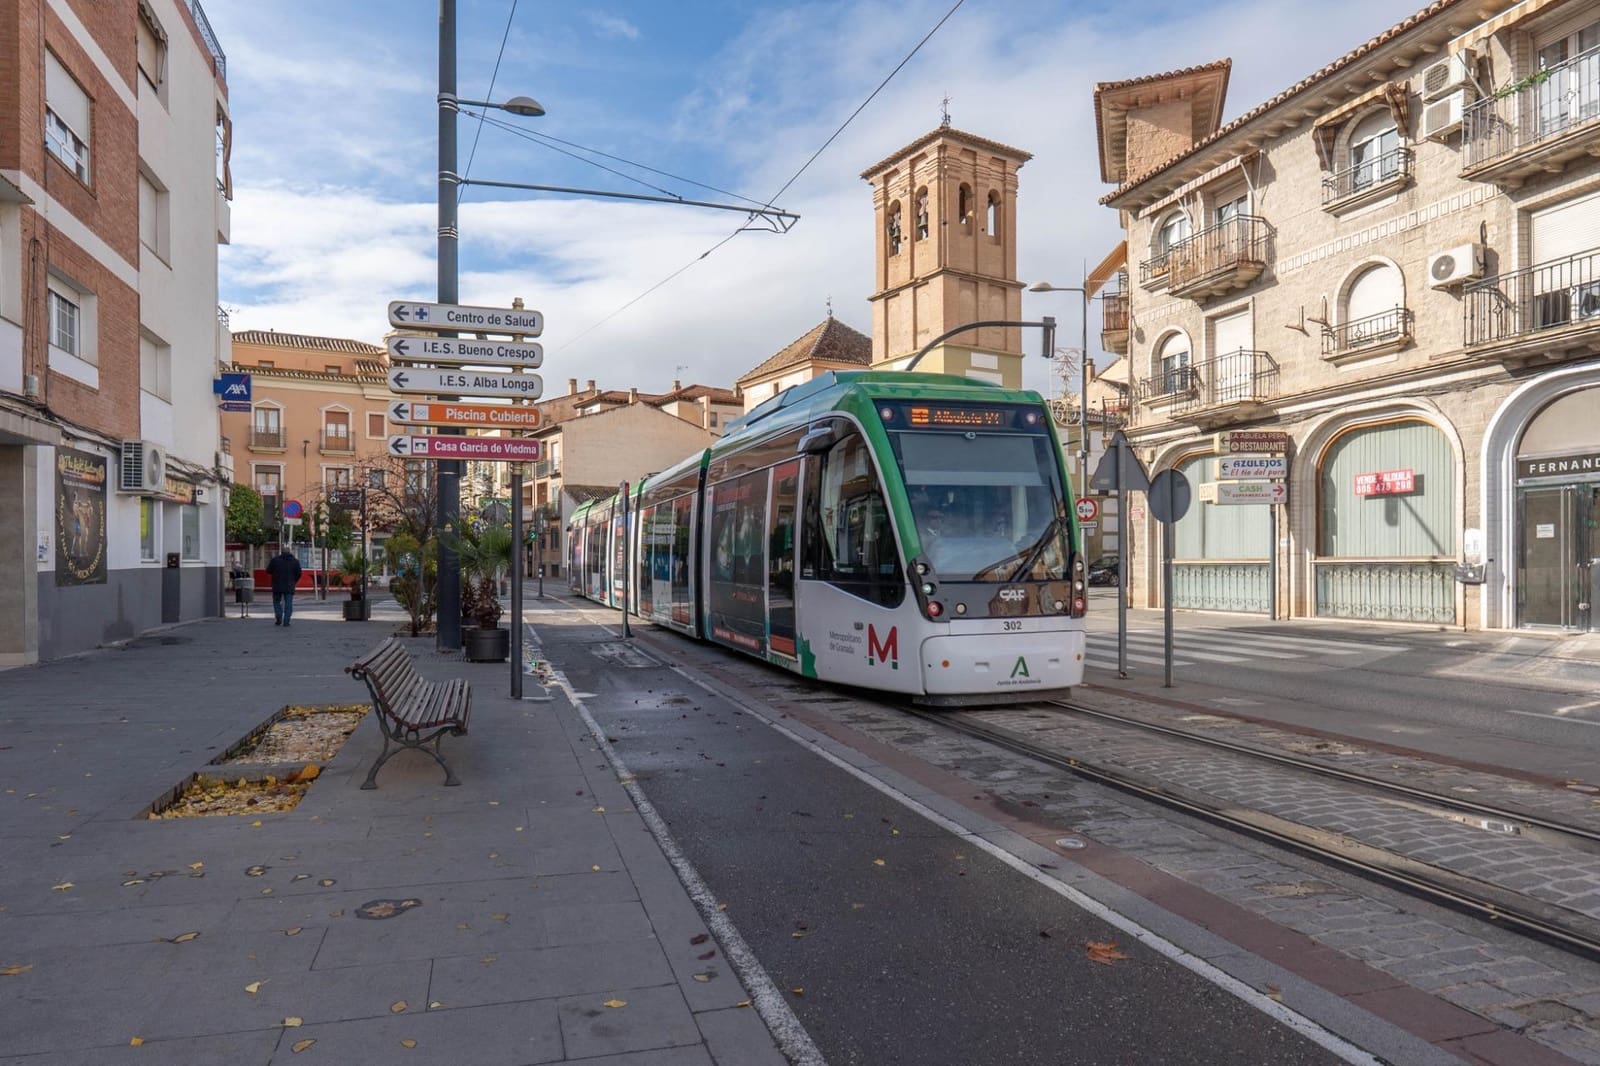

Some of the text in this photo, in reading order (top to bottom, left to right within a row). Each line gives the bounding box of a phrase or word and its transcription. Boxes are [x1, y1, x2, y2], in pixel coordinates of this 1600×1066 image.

[447, 310, 536, 328] Centro de Salud
[423, 341, 536, 361] I.E.S. Bueno Crespo
[225, 383, 248, 395] AXA
[439, 374, 535, 392] I.E.S. Alba Longa
[445, 407, 536, 423] Piscina Cubierta
[434, 441, 457, 452] Casa
[491, 443, 502, 454] de
[504, 444, 537, 455] Viedma
[1240, 442, 1286, 451] RESTAURANTE
[1233, 459, 1282, 468] AZULEJOS
[999, 589, 1025, 601] CAF
[1003, 620, 1023, 631] 302
